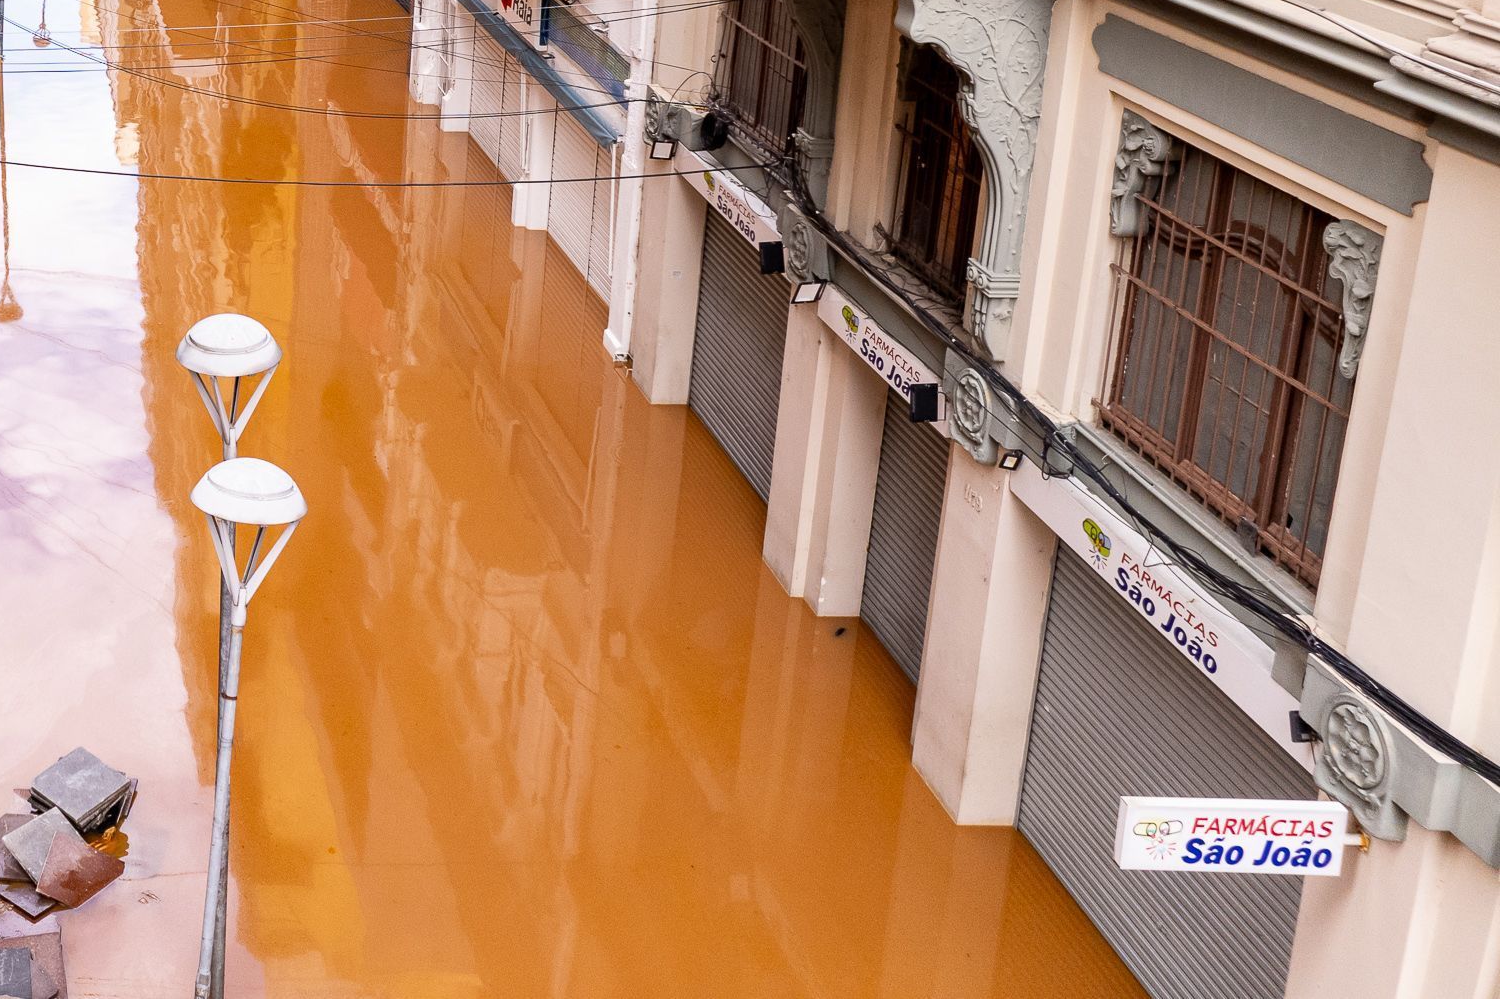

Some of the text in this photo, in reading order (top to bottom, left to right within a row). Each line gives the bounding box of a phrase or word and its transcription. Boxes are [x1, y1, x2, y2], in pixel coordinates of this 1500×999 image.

[716, 195, 756, 242] São João
[718, 185, 756, 225] FARMÁCIAS
[860, 338, 912, 397] São Joã
[864, 326, 921, 383] FARMÁCIAS
[1114, 567, 1218, 674] São João
[1121, 552, 1219, 648] FARMÁCIAS
[1191, 815, 1333, 838] FARMÁCIAS
[1181, 837, 1333, 869] São João
